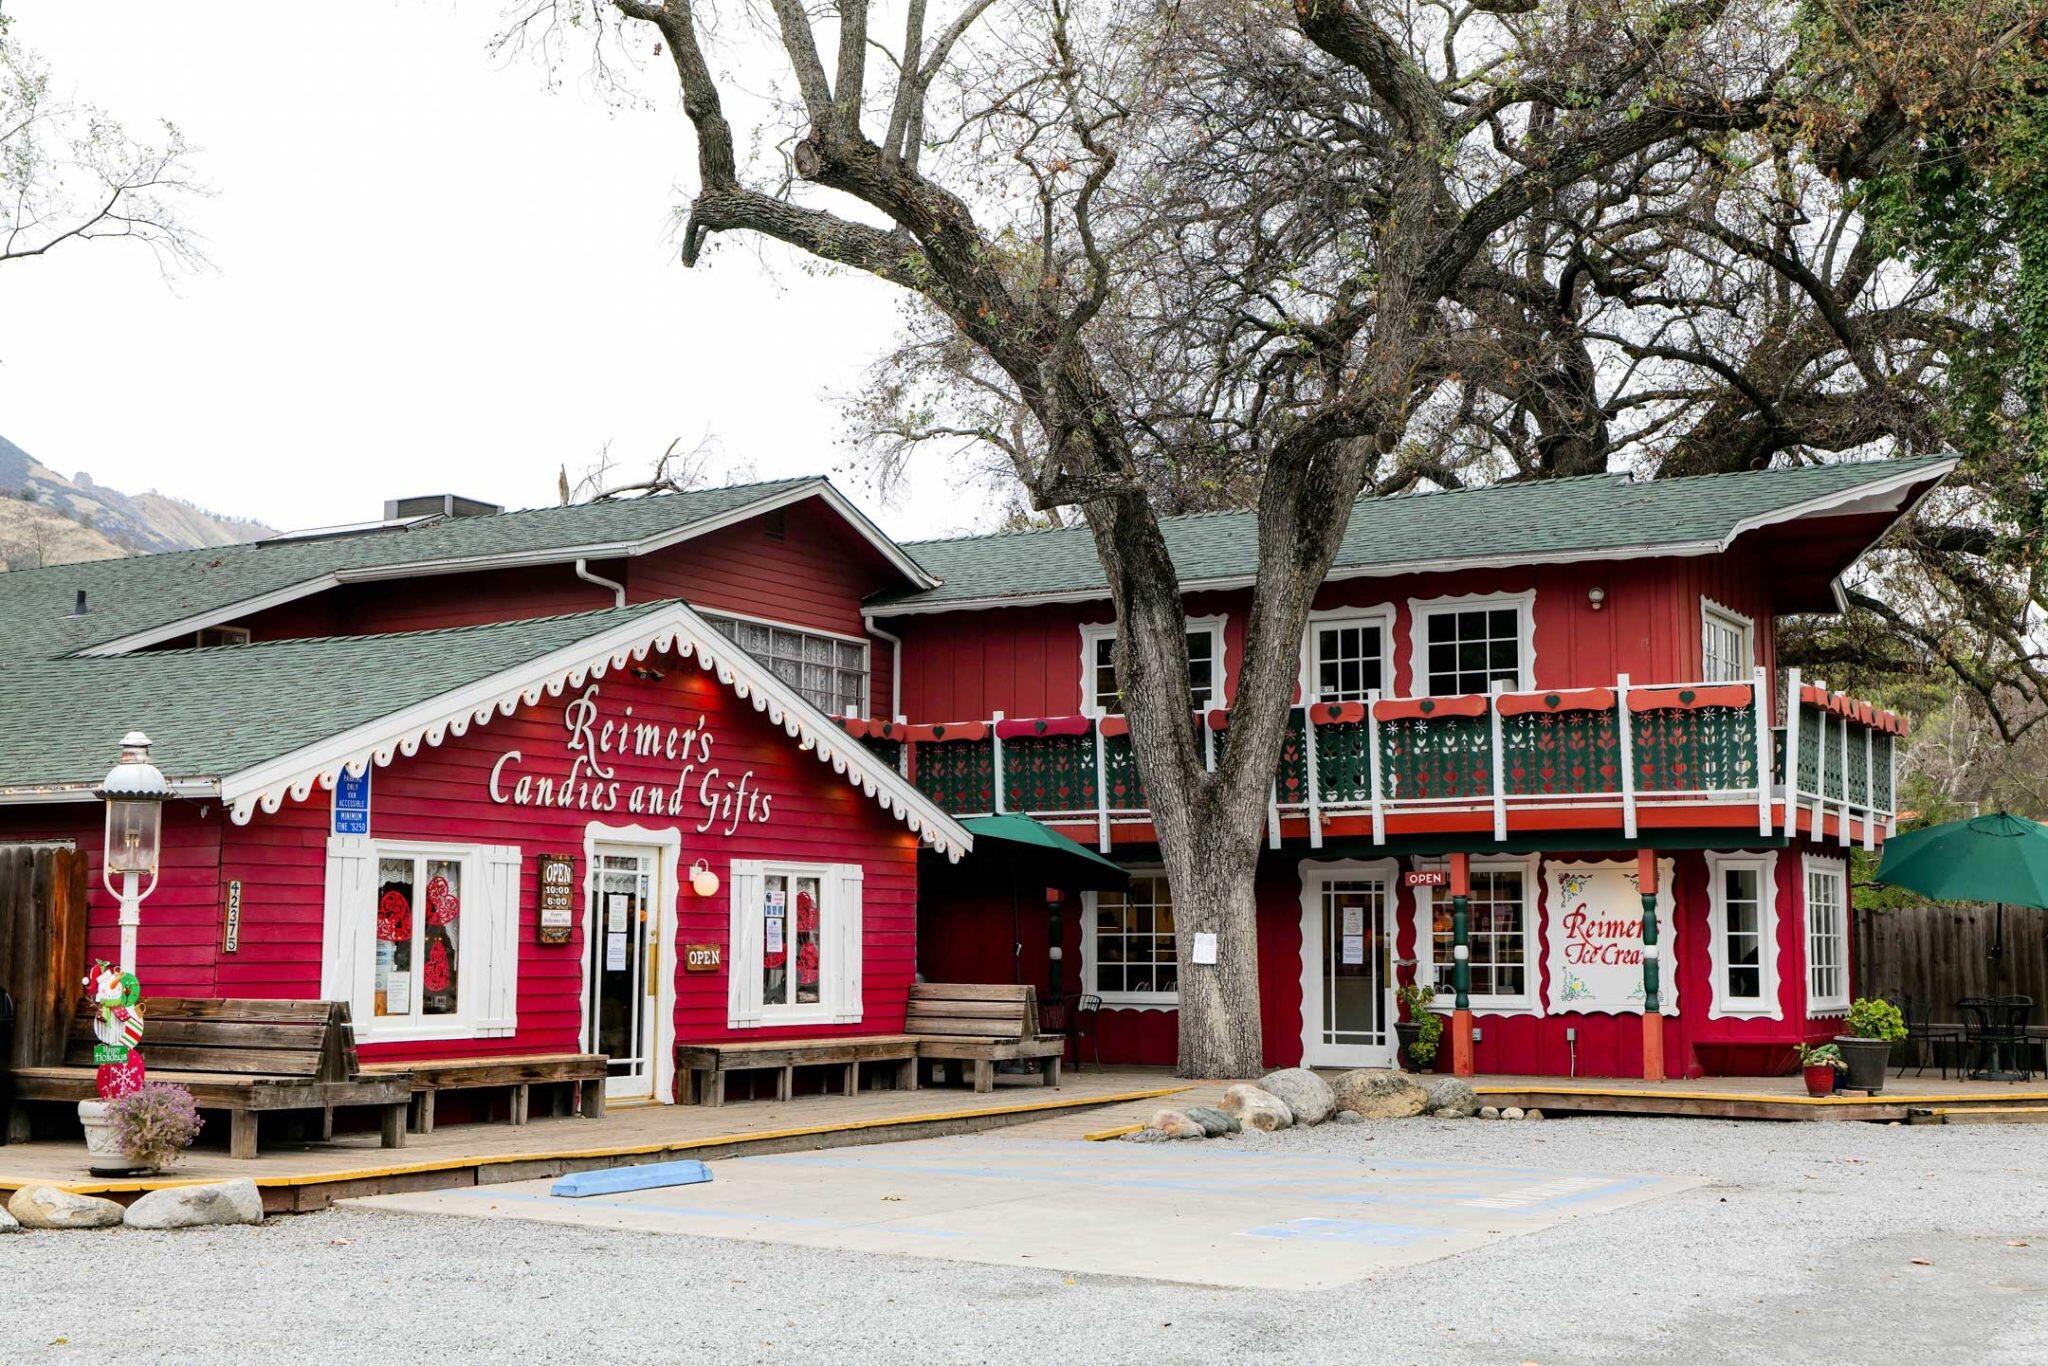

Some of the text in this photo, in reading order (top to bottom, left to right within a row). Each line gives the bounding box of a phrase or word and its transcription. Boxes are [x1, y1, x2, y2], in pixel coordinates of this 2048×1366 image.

[565, 684, 714, 779] Reimer's
[346, 783, 358, 791] ONLY
[489, 751, 772, 836] Candies and Gifts
[338, 800, 365, 808] ACCESSIBLE
[340, 812, 363, 821] MINIMUM
[336, 822, 348, 831] FINE
[546, 862, 572, 884] OPEN
[1409, 872, 1442, 884] OPEN
[545, 885, 570, 895] 10:00
[547, 897, 567, 906] 6:00
[228, 882, 240, 950] 42375
[689, 950, 720, 965] OPEN
[1564, 942, 1660, 966] Ice Crea
[102, 1045, 121, 1055] Happy
[95, 1053, 127, 1063] Holidays
